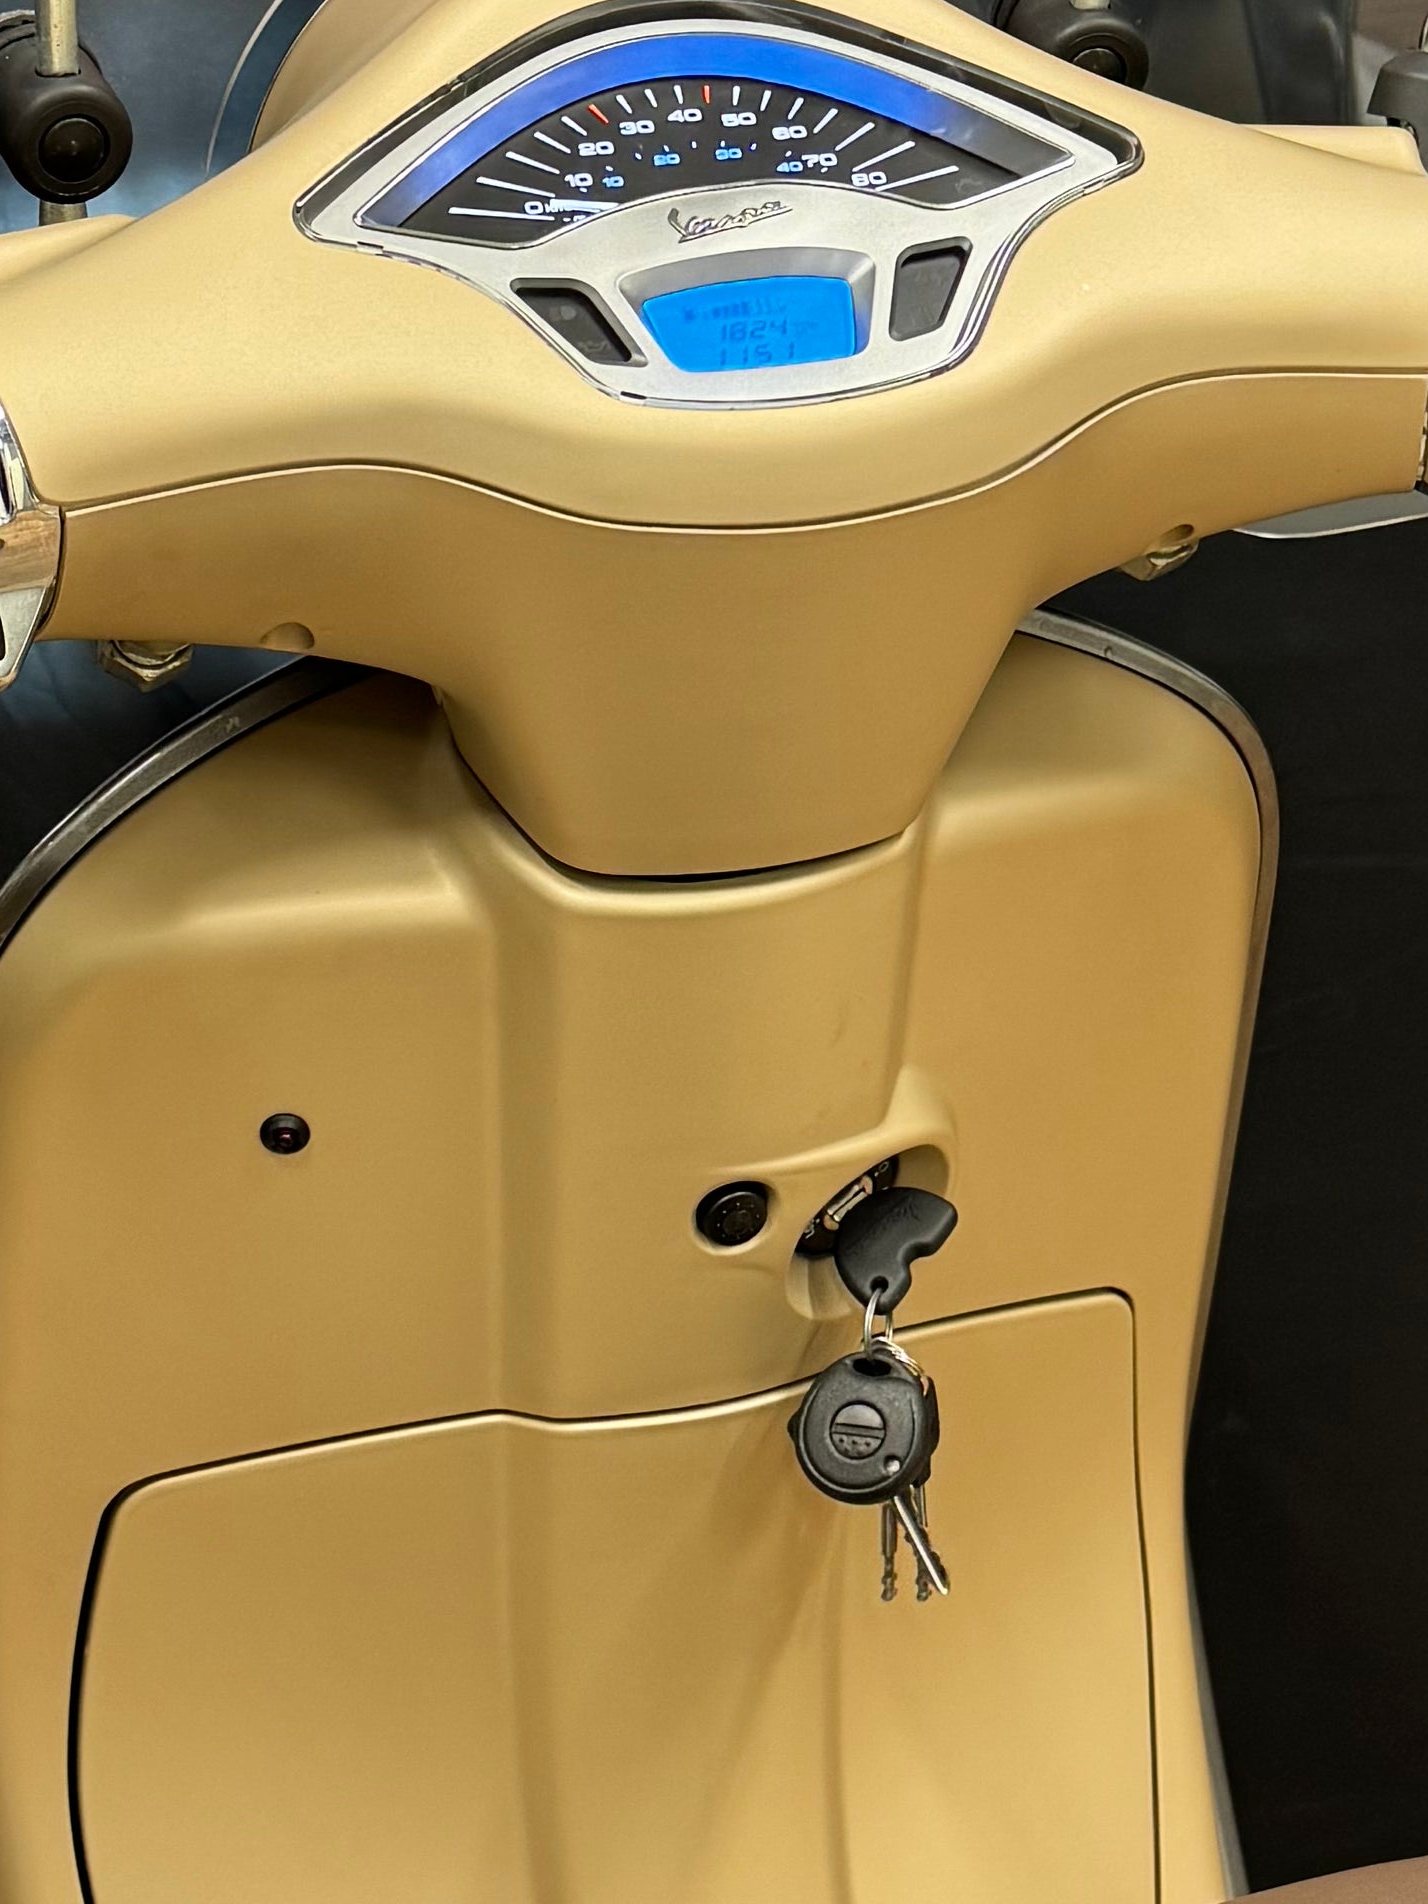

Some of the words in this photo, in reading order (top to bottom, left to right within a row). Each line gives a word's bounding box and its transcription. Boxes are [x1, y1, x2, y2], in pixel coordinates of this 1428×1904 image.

[667, 108, 703, 123] 40
[721, 112, 757, 127] 50
[619, 120, 655, 136] 30
[772, 125, 808, 141] 60
[578, 141, 615, 156] 20
[776, 161, 804, 173] 40
[801, 153, 838, 168] 70
[564, 172, 594, 188] 10
[602, 175, 625, 188] 10
[851, 171, 887, 187] 80
[524, 200, 544, 215] 0
[667, 200, 794, 244] Vespa
